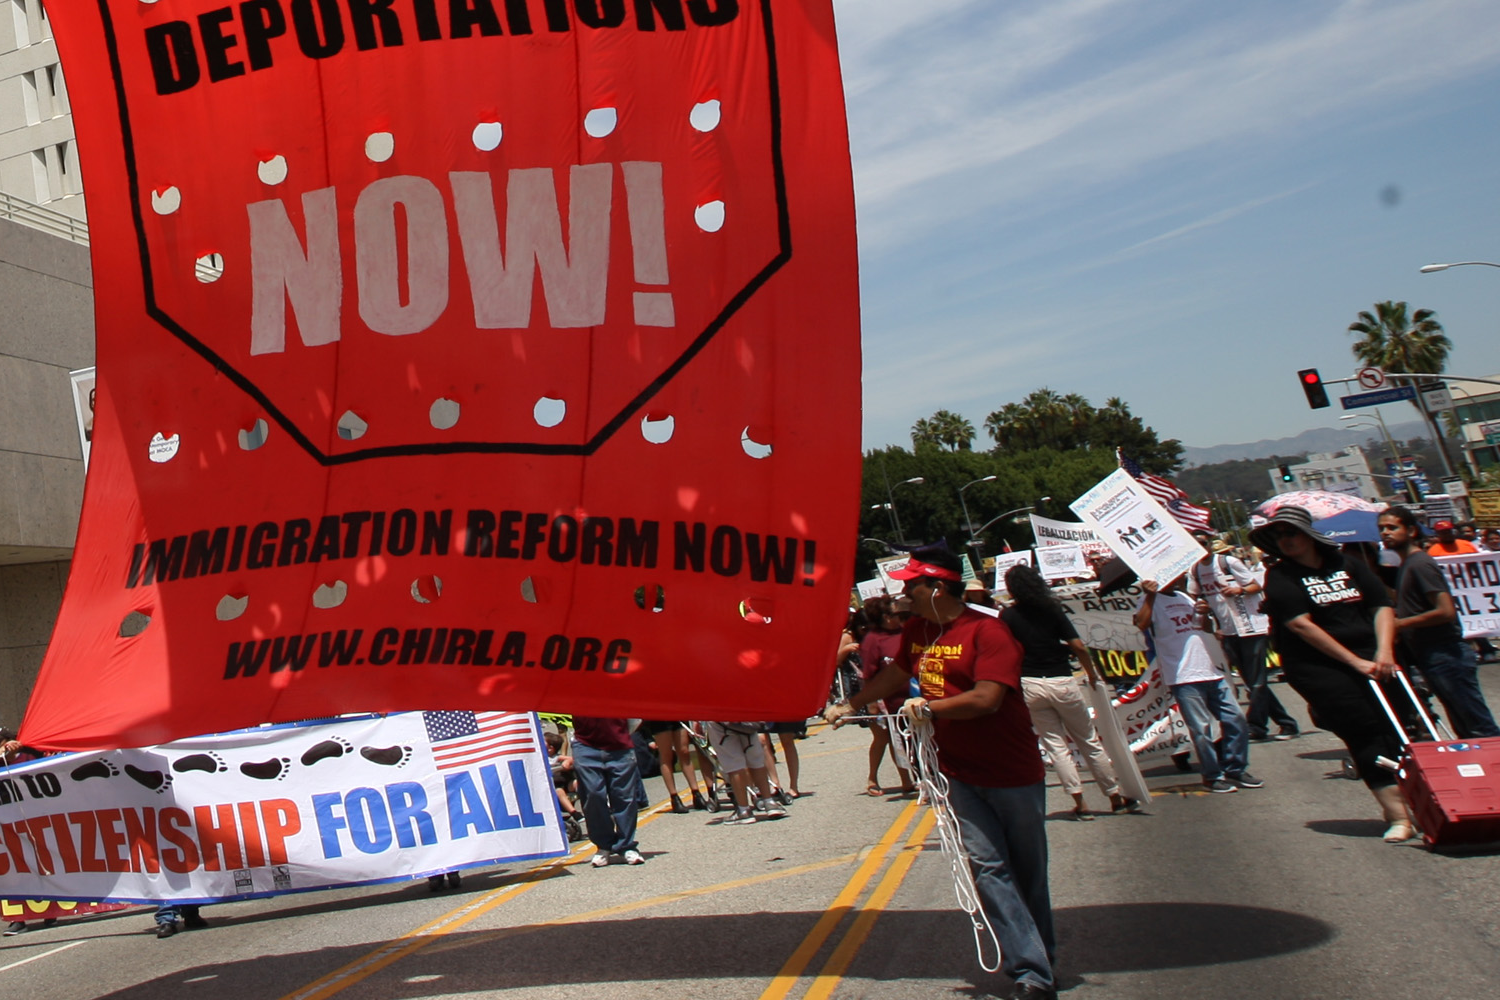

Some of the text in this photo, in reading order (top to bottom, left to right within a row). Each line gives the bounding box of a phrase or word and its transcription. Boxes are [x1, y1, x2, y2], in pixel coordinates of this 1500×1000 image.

[247, 161, 675, 355] NOW!
[125, 507, 818, 588] IMMIGRATION REFORM NOW!
[1037, 525, 1095, 541] LEGALIZACIÓN
[1311, 588, 1360, 604] VENDING
[222, 628, 633, 681] WWW.CHIRLA.ORG
[20, 772, 62, 799] to
[311, 781, 438, 859] FOR
[443, 759, 545, 840] ALL
